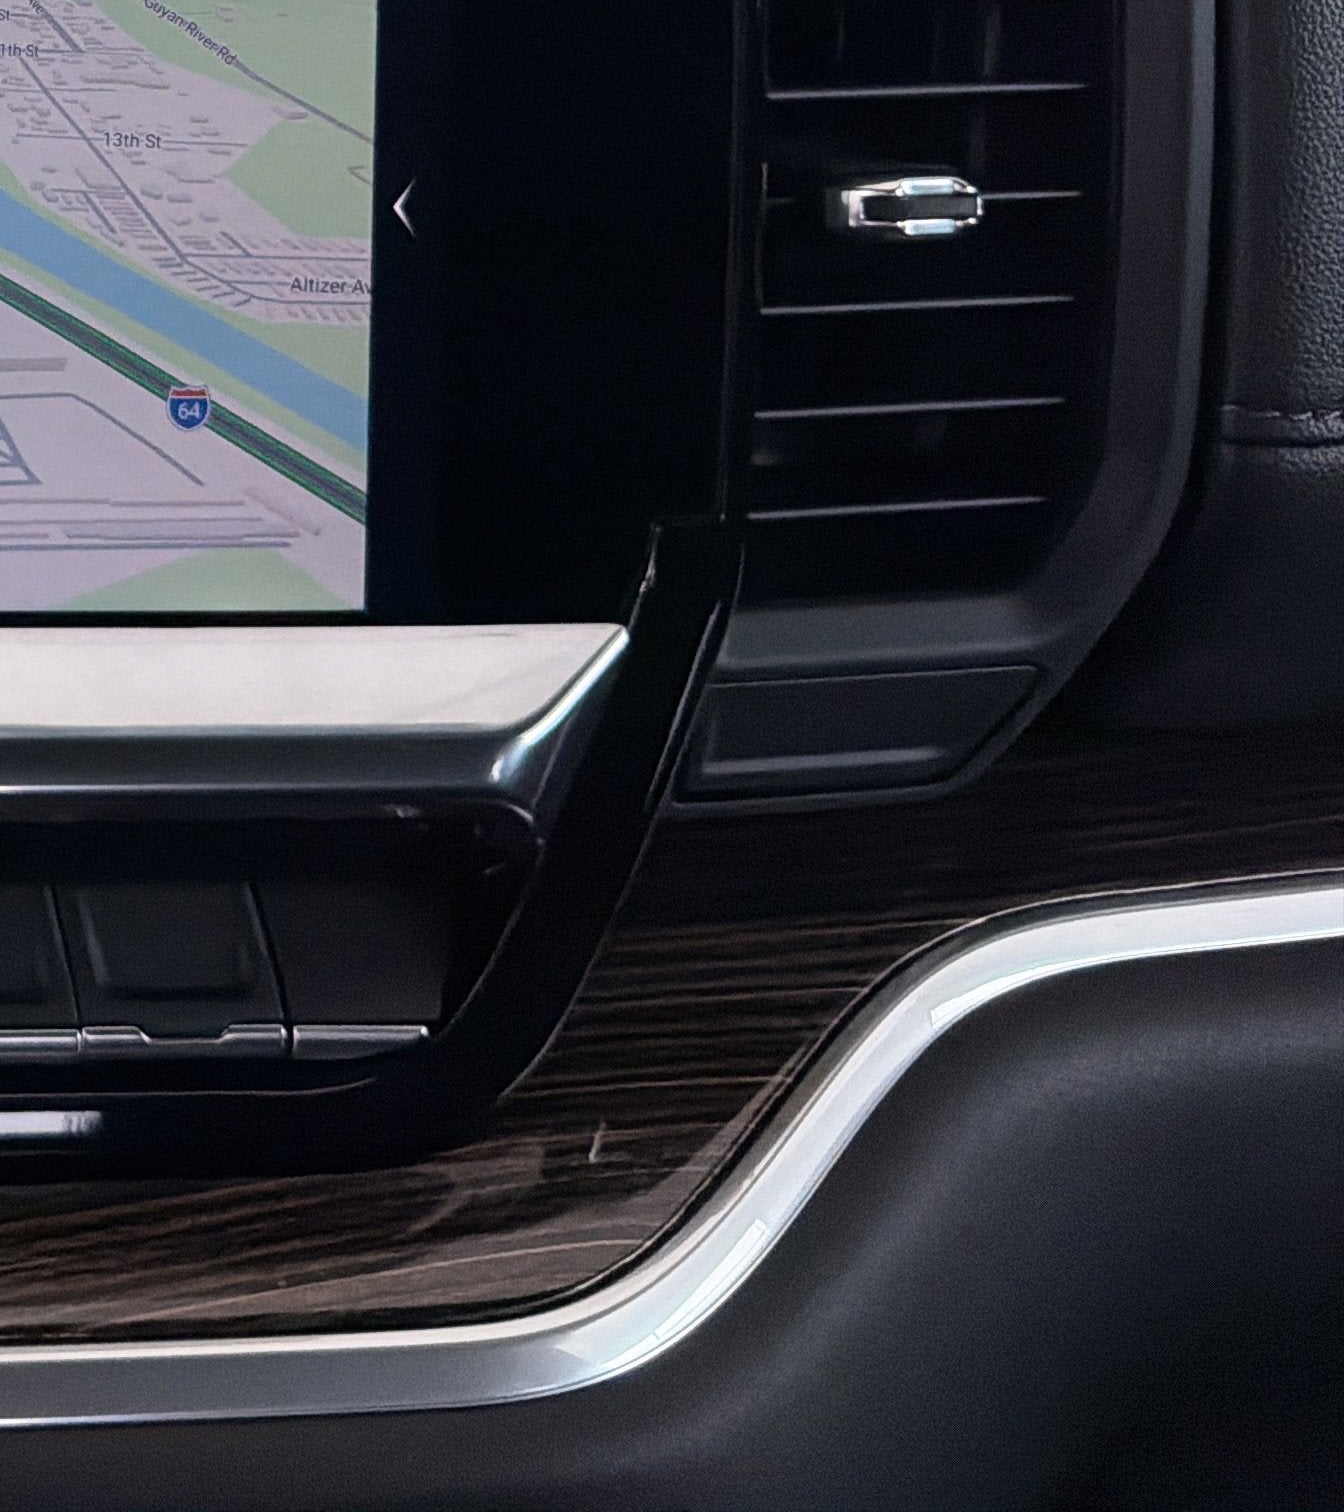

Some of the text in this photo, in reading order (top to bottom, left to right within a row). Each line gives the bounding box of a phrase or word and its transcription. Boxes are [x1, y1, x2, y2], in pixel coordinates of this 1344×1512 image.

[25, 45, 39, 57] St
[185, 21, 216, 50] River
[215, 46, 237, 66] Rd
[103, 132, 162, 149] 13th St
[290, 276, 372, 294] Altizer Av
[177, 401, 201, 420] 64
